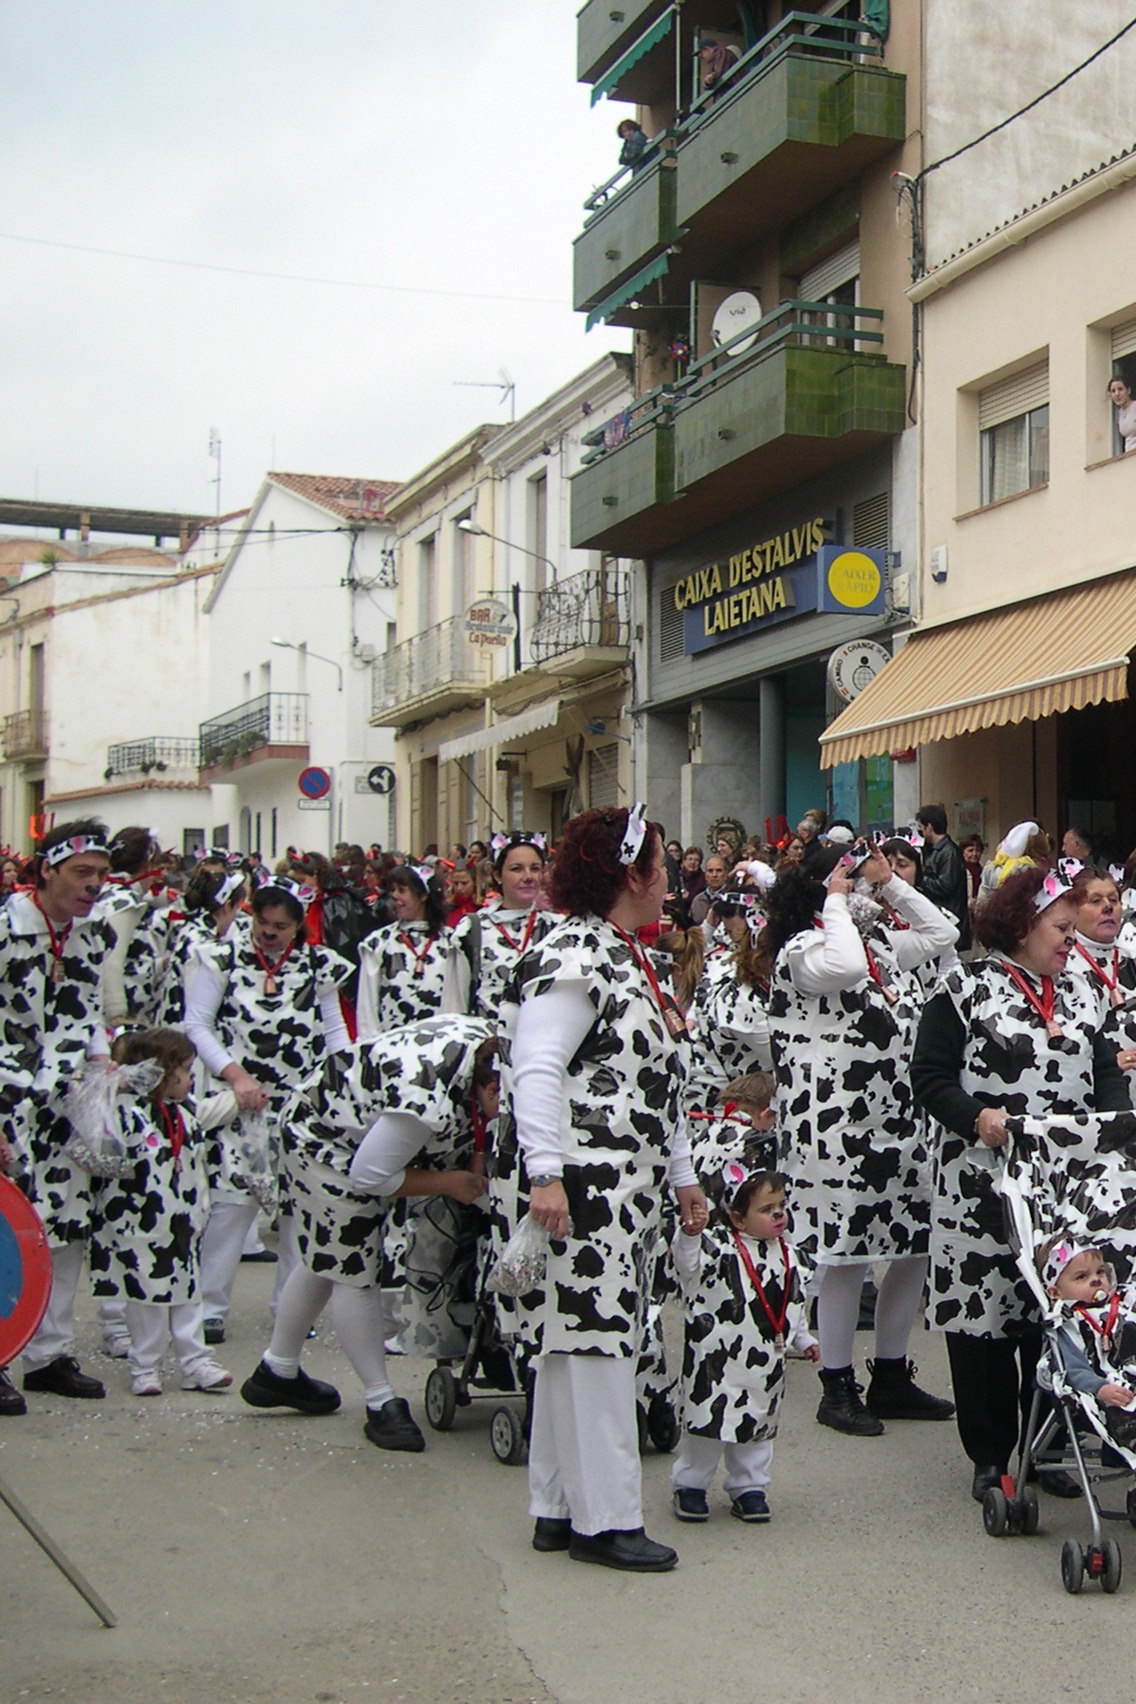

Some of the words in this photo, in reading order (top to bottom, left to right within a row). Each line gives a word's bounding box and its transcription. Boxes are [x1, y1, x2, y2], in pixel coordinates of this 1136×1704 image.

[675, 564, 722, 611] CAIXA
[729, 517, 824, 588] D'ESTALVIS
[832, 567, 876, 581] CAIXER
[704, 576, 786, 636] LAIETANA
[470, 608, 490, 623] BAR
[847, 641, 876, 653] CHANGE
